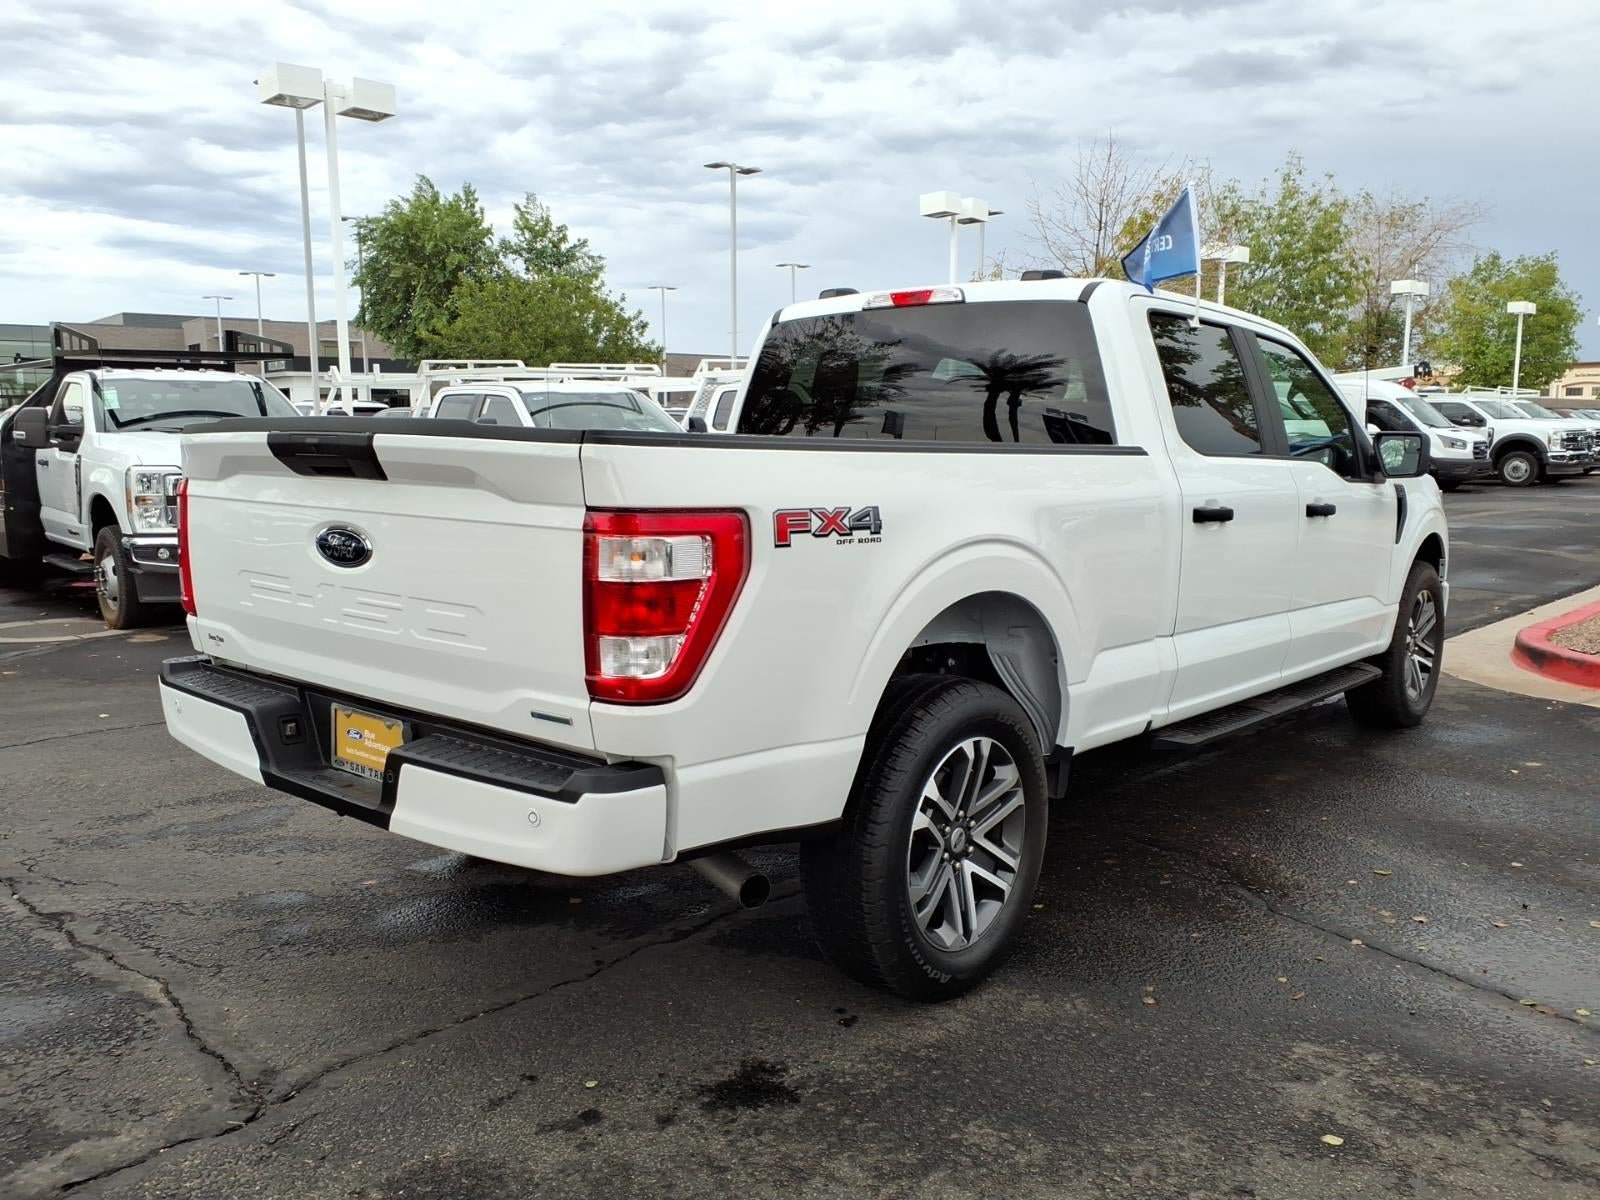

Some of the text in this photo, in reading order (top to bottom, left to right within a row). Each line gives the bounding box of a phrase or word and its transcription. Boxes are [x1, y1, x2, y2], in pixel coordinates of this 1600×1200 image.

[773, 506, 882, 548] FX4
[836, 536, 882, 546] OFF ROAD
[350, 762, 366, 775] SAN
